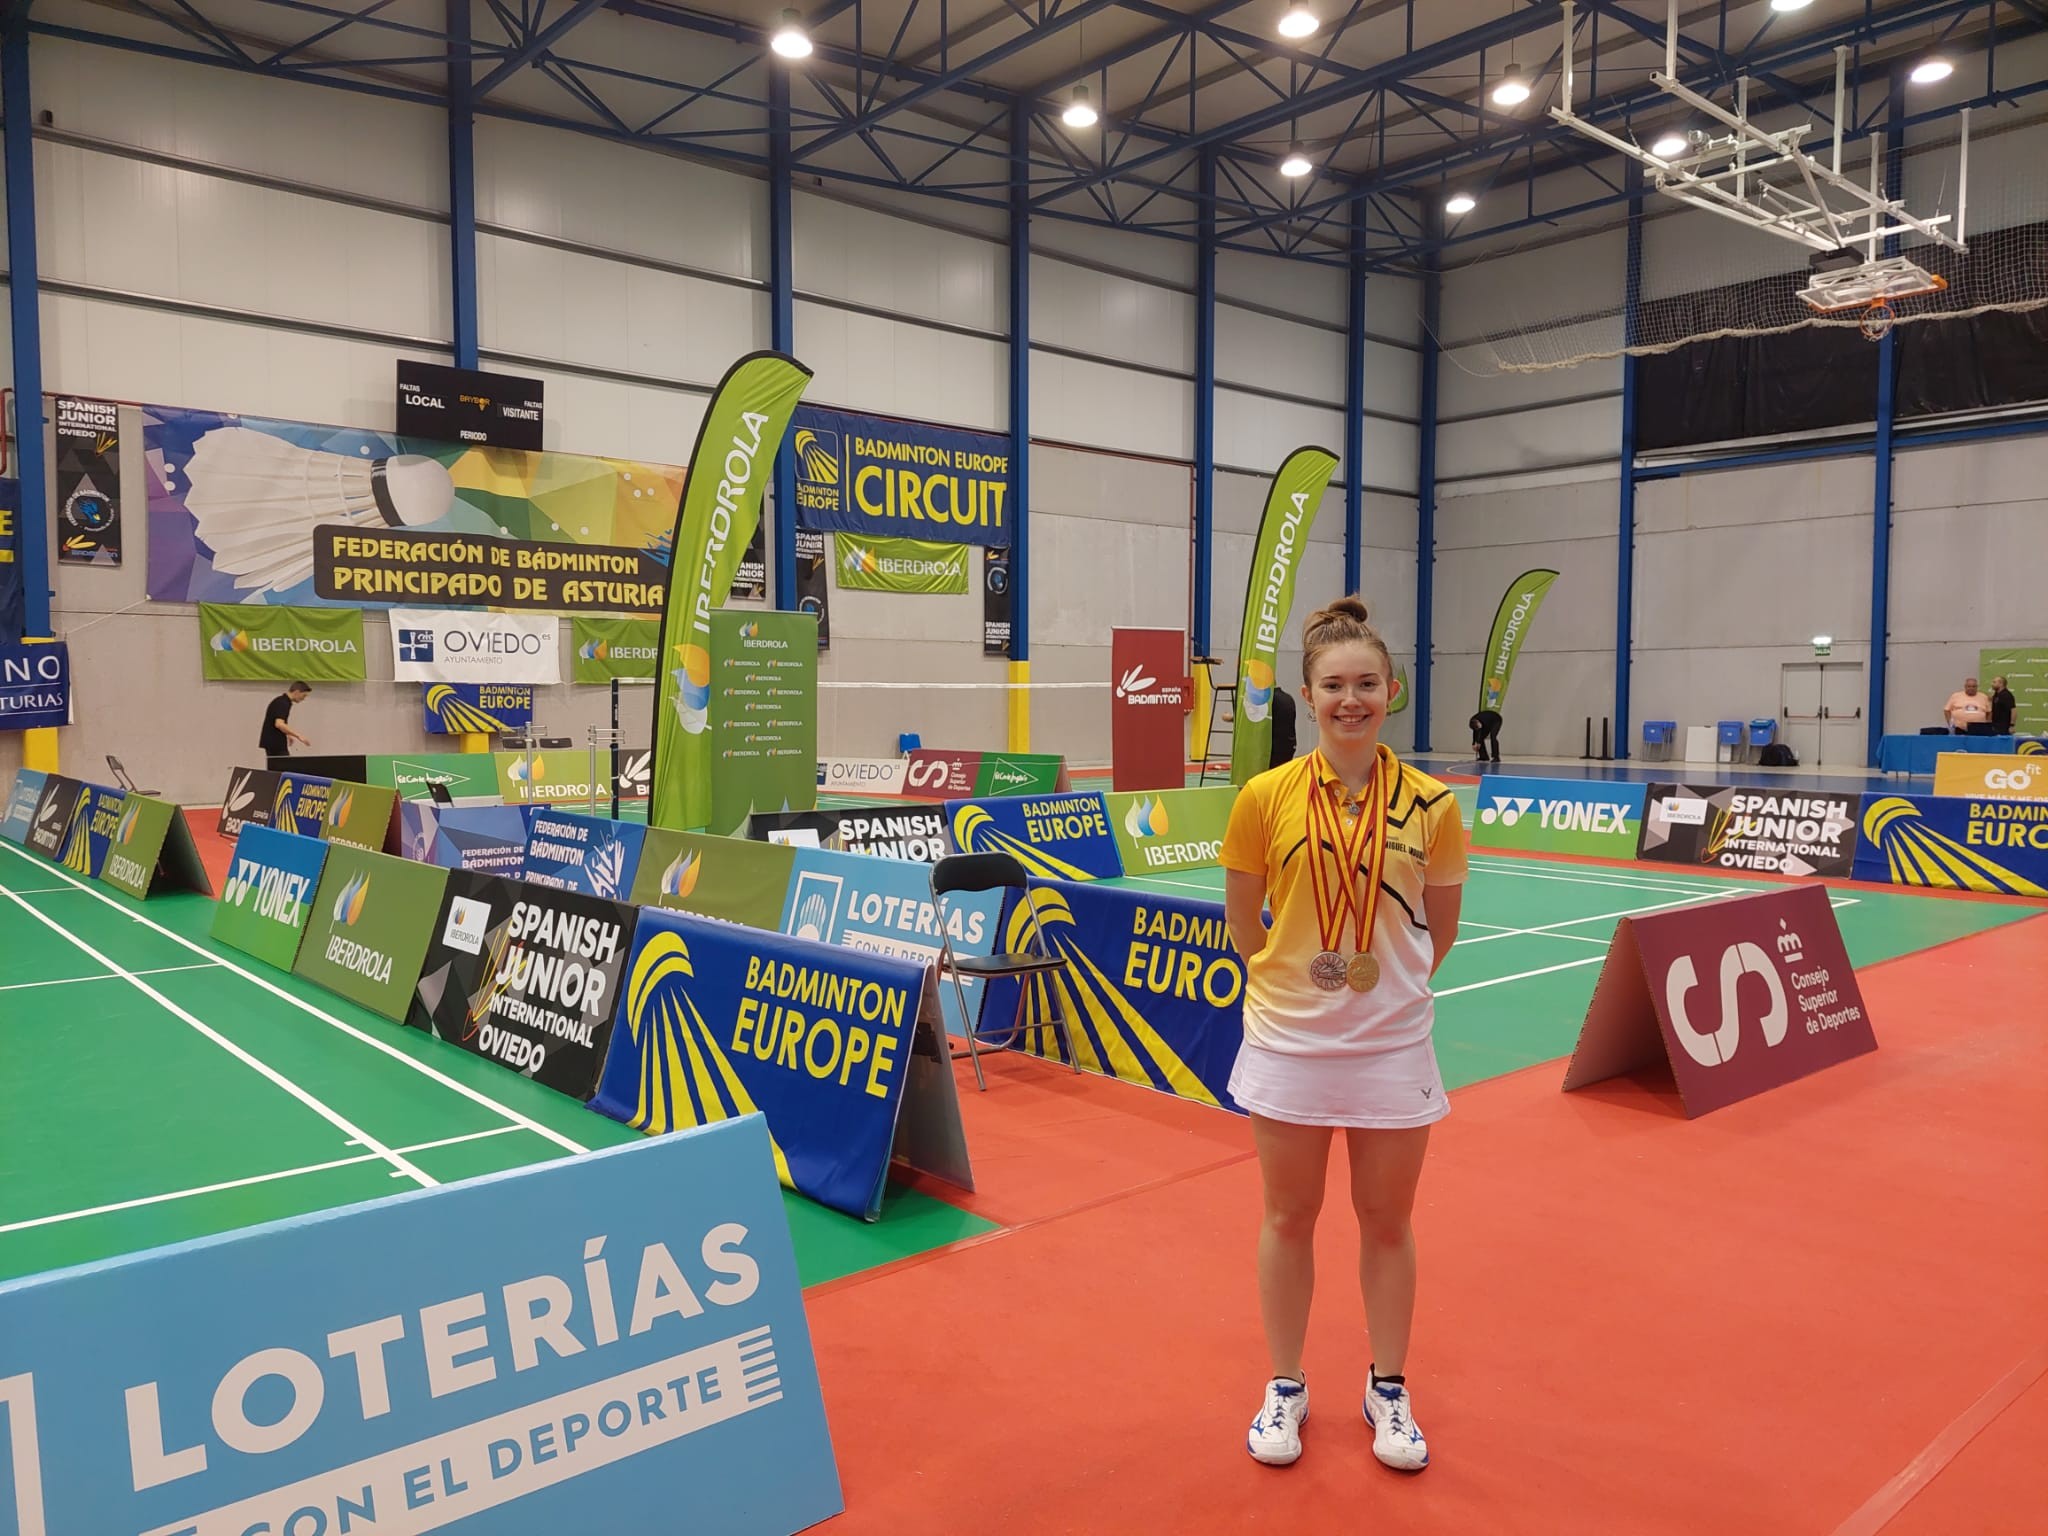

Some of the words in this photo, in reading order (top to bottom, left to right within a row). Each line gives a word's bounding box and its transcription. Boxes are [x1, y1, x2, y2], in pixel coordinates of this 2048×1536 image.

[400, 383, 420, 392] FALTAS
[58, 400, 116, 415] SPANISH
[405, 394, 445, 409] LOCAL
[503, 406, 539, 420] VISITANTE
[58, 410, 116, 426] JUNIOR
[58, 428, 97, 438] OVIEDO
[460, 430, 487, 441] PERIODO
[855, 437, 950, 467] BADMINTON
[955, 451, 1008, 474] EUROPE
[854, 465, 1007, 527] CIRCUIT
[333, 536, 484, 564] FEDERACIÓN
[491, 547, 511, 567] DE
[517, 547, 639, 575] BÁDMINTON
[740, 562, 764, 570] ANISH
[879, 557, 961, 577] IBERDROLA
[736, 570, 764, 578] UNIOR
[1256, 492, 1309, 653] IBERDROLA
[333, 567, 501, 598] PRINCIPADO
[513, 577, 548, 600] DE
[562, 580, 664, 607] ASTURIA
[252, 638, 357, 653] IBERDROLA
[444, 630, 541, 655] OVIEDO
[744, 639, 788, 649] IBERDROLA
[1495, 592, 1535, 674] IBERDROLA
[444, 656, 503, 665] AYUNTAMIENTO
[610, 647, 659, 660] IBERDR
[479, 685, 531, 696] BADMINTON
[479, 696, 531, 710] EUROPE
[1128, 694, 1182, 705] BADMINTON
[832, 763, 893, 781] OVIEDO
[1984, 768, 2031, 790] GO
[2025, 763, 2042, 775] fit
[1022, 797, 1100, 818] BADMINTON
[1539, 798, 1631, 834] YONEX
[1731, 794, 1847, 820] SPANISH
[1969, 803, 2048, 822] BADMIN
[534, 819, 576, 840] FEDERACIÓN
[576, 827, 588, 842] DE
[838, 815, 943, 841] SPANISH
[1026, 813, 1108, 844] EUROPE
[1725, 815, 1842, 844] JUNIOR
[1966, 821, 2048, 850] EURO
[461, 846, 511, 858] FEDERACIÓN
[513, 846, 525, 854] DE
[529, 836, 585, 867] BÁDMINTON
[1144, 840, 1223, 867] IBERDRO
[1724, 838, 1841, 858] INTERNATIONAL
[461, 856, 525, 869] BÁDMINTON
[1720, 853, 1793, 872] OVIEDO
[253, 865, 311, 928] YONEX
[847, 890, 986, 945] LOTERÍAS
[1133, 906, 1239, 954] BADMIN
[507, 901, 621, 964] SPANISH
[325, 934, 393, 985] IBERDROLA
[495, 944, 606, 1017] JUNIOR
[1124, 941, 1242, 1008] EURO
[1791, 966, 1829, 990] Consejo
[744, 955, 907, 1028] BADMINTON
[1798, 986, 1838, 1012] Superior
[489, 992, 594, 1049] INTERNATIONAL
[1806, 1016, 1820, 1034] de
[1819, 1006, 1861, 1031] Deportes
[478, 1024, 545, 1073] OVIEDO
[731, 999, 898, 1099] EUROPE
[125, 1223, 760, 1492] LOTERÍAS
[239, 1484, 377, 1536] ON
[403, 1457, 468, 1510] EL
[488, 1366, 722, 1480] DEPORTE
